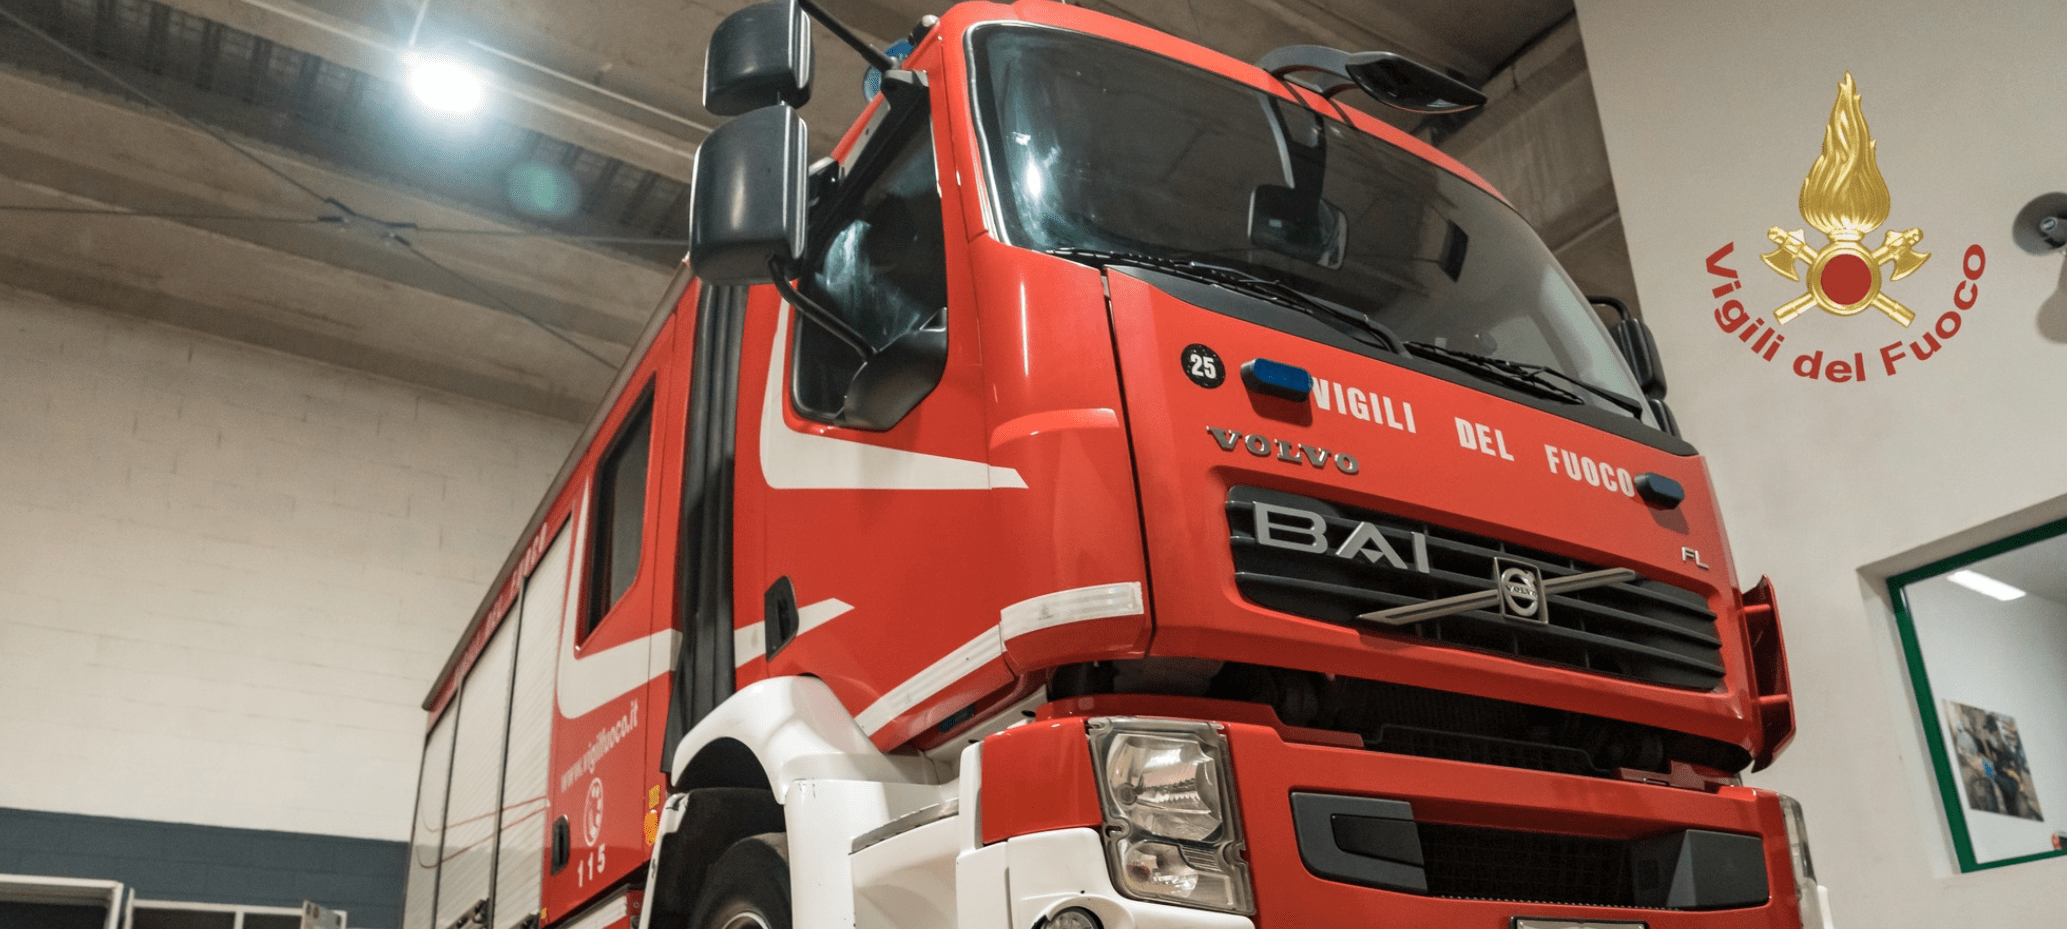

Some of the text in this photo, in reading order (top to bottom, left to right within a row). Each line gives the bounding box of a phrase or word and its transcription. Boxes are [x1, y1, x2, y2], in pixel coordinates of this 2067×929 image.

[1190, 353, 1217, 379] 25
[1206, 425, 1360, 475] VOLVO
[1312, 376, 1636, 498] VIGILI DEL FUOCO
[1252, 500, 1430, 574] BAI
[1681, 546, 1710, 570] FL
[1504, 585, 1537, 596] VOLVO
